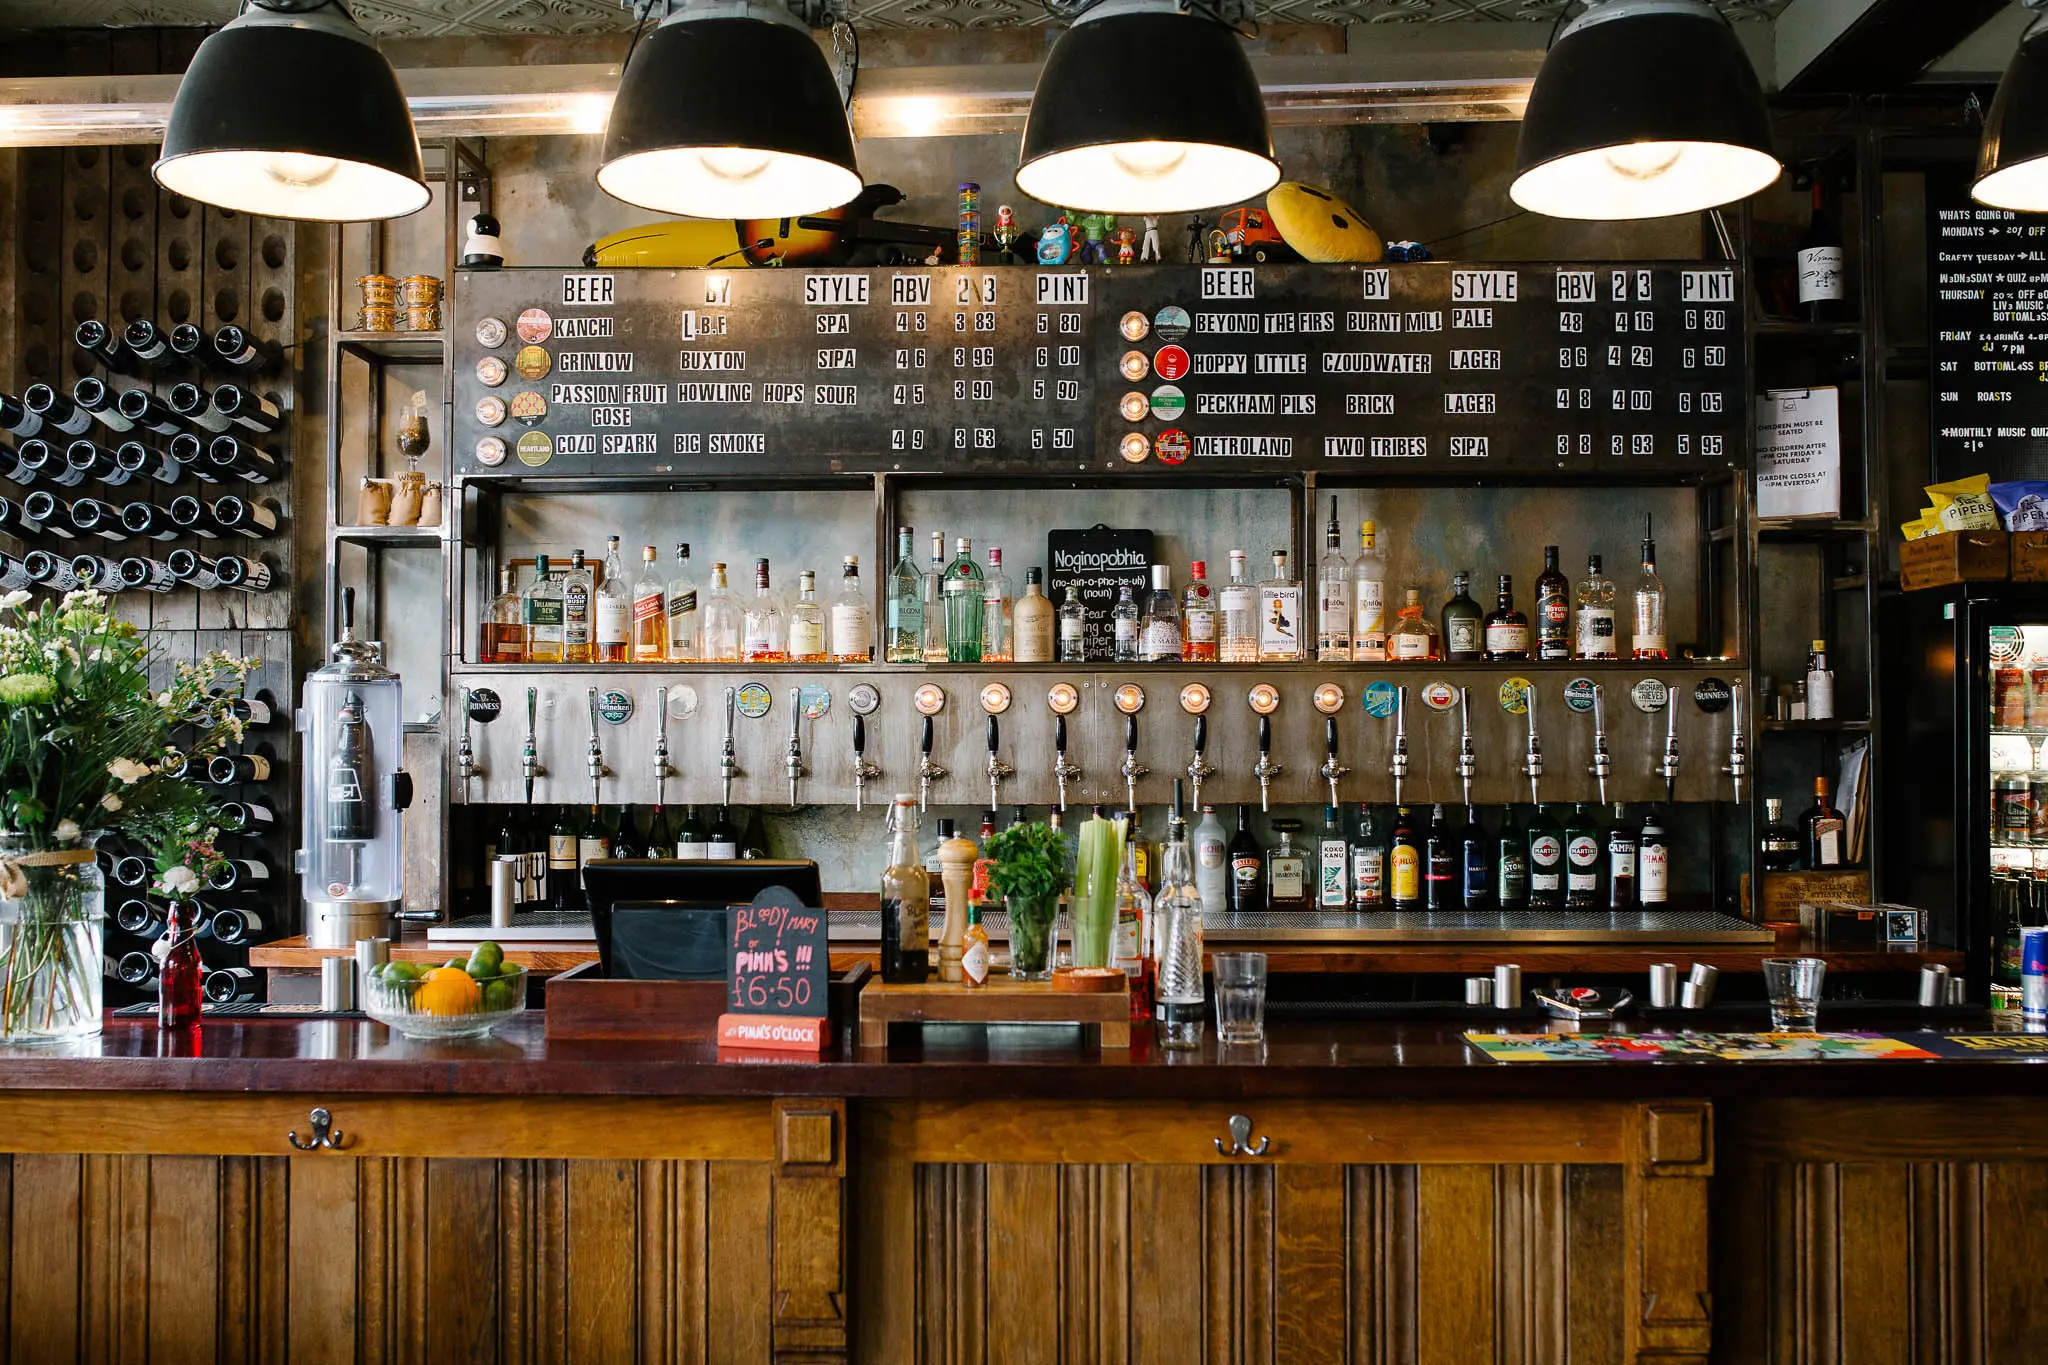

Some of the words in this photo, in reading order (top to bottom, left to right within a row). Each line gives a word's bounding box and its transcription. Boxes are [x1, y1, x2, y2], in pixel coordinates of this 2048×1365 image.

[1939, 210, 1970, 220] WHATS
[1975, 210, 2001, 220] GOING
[2003, 211, 2015, 220] ON
[1942, 227, 1985, 237] MONDAYS
[2028, 226, 2046, 237] OFF
[2029, 251, 2046, 261] ALL
[2007, 273, 2027, 283] QUIZ
[564, 278, 613, 302] BEER
[806, 277, 867, 302] STYLE
[893, 279, 930, 302] ABV
[1038, 277, 1087, 302] PINT
[1203, 270, 1253, 298] BEER
[1365, 270, 1389, 297] BY
[1454, 273, 1515, 299] STYLE
[1560, 274, 1594, 300] ABV
[1684, 274, 1732, 299] PINT
[1940, 290, 1985, 300] THURSDAY
[2018, 290, 2035, 299] OFF
[2016, 301, 2044, 310] MUSIC
[555, 319, 612, 337] KANCHI
[818, 315, 848, 333] SPA
[956, 314, 965, 330] 3
[975, 313, 994, 330] 83
[1038, 315, 1047, 332] 5
[1061, 315, 1079, 332] 80
[1197, 314, 1258, 332] BEYOND
[1266, 314, 1293, 332] THE
[1300, 313, 1333, 331] FIRS
[1348, 313, 1400, 331] BURNT
[1406, 313, 1441, 331] MILL
[1453, 310, 1491, 327] PALE
[1561, 313, 1581, 331] 48
[1617, 314, 1627, 331] 4
[1636, 313, 1653, 330] 16
[1686, 311, 1696, 328] 6
[1705, 311, 1724, 329] 30
[2010, 345, 2025, 354] PM
[560, 354, 632, 371] GRINLOW
[681, 352, 744, 370] BUXTON
[819, 350, 855, 368] SIPA
[956, 349, 964, 365] 3
[974, 348, 993, 366] 96
[1037, 348, 1046, 365] 6
[1060, 347, 1079, 365] 00
[1195, 355, 1246, 373] HOPPY
[1256, 355, 1305, 373] LITTLE
[1451, 351, 1500, 369] LAGER
[1610, 347, 1620, 365] 4
[1633, 347, 1652, 365] 29
[1684, 349, 1694, 367] 6
[1705, 347, 1724, 365] 50
[1940, 362, 1958, 371] SAT
[553, 385, 619, 403] PASSION
[624, 385, 666, 402] FRUIT
[679, 384, 751, 402] HOWLING
[764, 385, 803, 402] HOPS
[816, 386, 856, 404] SOUR
[956, 382, 964, 399] 3
[973, 382, 992, 399] 90
[1035, 381, 1043, 398] 5
[1058, 382, 1077, 399] 90
[1940, 392, 1958, 401] SUN
[1977, 392, 2012, 401] ROASTS
[1198, 395, 1274, 413] PECKHAM
[1282, 396, 1314, 413] PILS
[1347, 396, 1393, 413] BRICK
[1445, 395, 1494, 412] LAGER
[1614, 390, 1624, 409] 4
[1632, 391, 1651, 409] 00
[1681, 394, 1690, 411] 6
[1702, 394, 1721, 411] 05
[593, 409, 630, 425] GOSE
[1758, 423, 1792, 431] CHILDREN
[1998, 427, 2026, 437] MUSIC
[604, 435, 655, 452] SPARK
[675, 435, 699, 452] BIG
[710, 435, 764, 452] SMOKE
[956, 430, 964, 447] 3
[975, 430, 994, 447] 63
[1033, 431, 1041, 447] 5
[1054, 430, 1073, 447] 50
[1195, 437, 1291, 456] METROLAND
[1325, 438, 1364, 455] TWO
[1372, 438, 1425, 455] TRIBES
[1452, 438, 1487, 455] SIPA
[1613, 436, 1622, 454] 3
[1633, 436, 1653, 454] 93
[1679, 436, 1688, 453] 5
[1703, 437, 1722, 454] 95
[1770, 444, 1804, 452] CHILDREN
[1772, 457, 1811, 465] SATURDAY
[1790, 472, 1815, 480] CLOSES
[1949, 502, 1994, 519] PIPERS
[1083, 588, 1112, 599] (noun)
[1280, 591, 1295, 599] bird
[1550, 611, 1565, 619] Club
[1695, 690, 1729, 700] GUINNESS
[787, 916, 819, 934] MARY
[738, 1025, 771, 1040] PIMM'S
[772, 1026, 814, 1042] O'CLOCK
